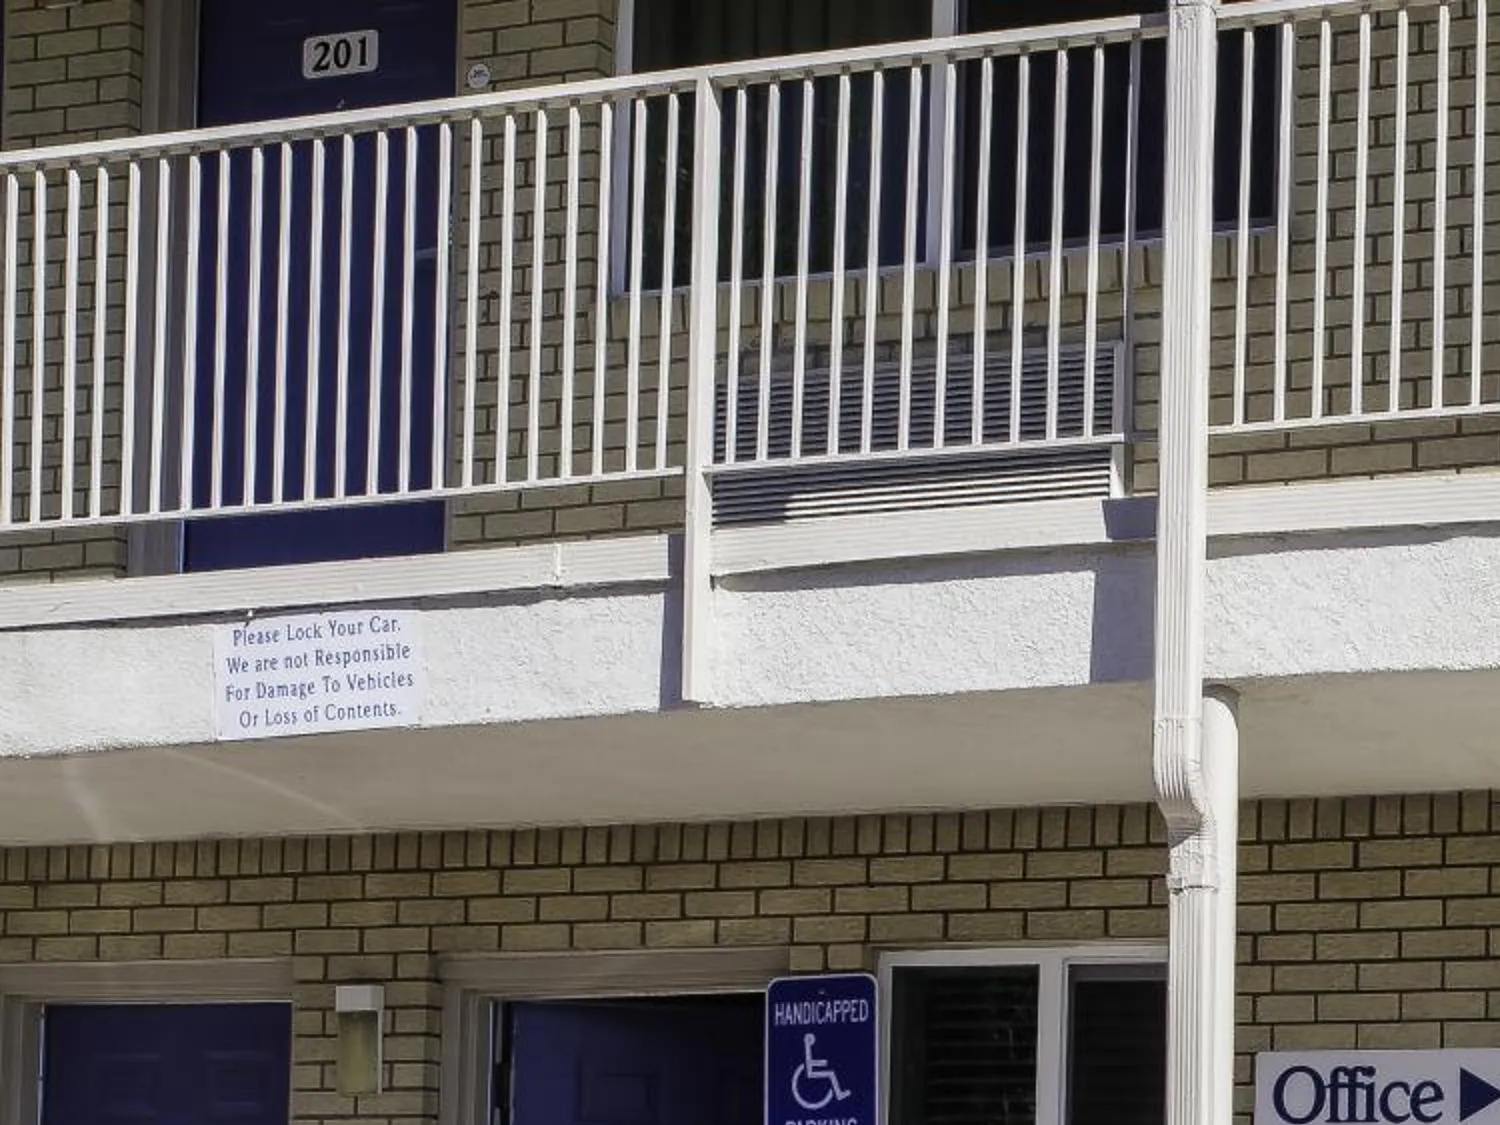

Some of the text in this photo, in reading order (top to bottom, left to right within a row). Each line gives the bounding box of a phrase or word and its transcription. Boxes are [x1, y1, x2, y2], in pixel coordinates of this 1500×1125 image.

[312, 36, 368, 72] 201
[233, 628, 280, 646] Please
[287, 623, 323, 641] Lock
[328, 619, 364, 637] Your
[226, 643, 411, 674] We are not Responsible
[225, 671, 414, 703] For Damage To Vehicles
[239, 710, 259, 729] Or
[265, 706, 298, 726] Loss
[303, 705, 320, 723] of
[774, 999, 869, 1025] HANDICAPPED
[1272, 1064, 1444, 1125] Office
